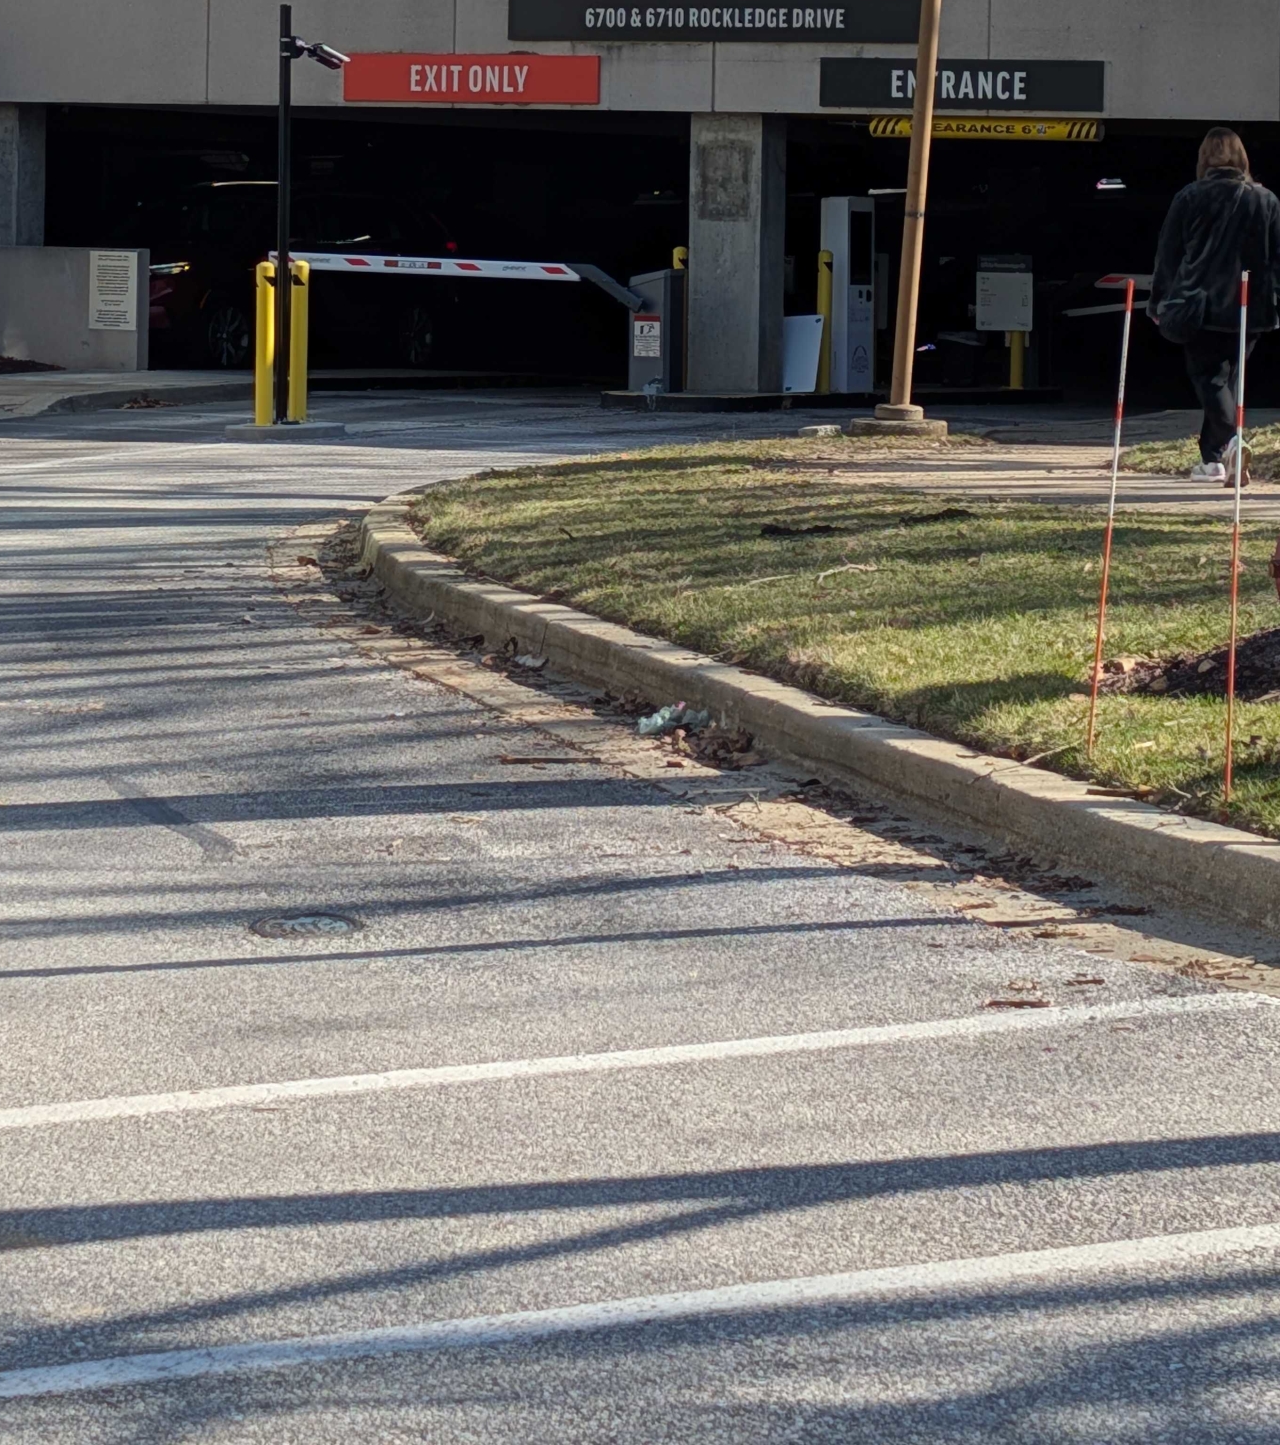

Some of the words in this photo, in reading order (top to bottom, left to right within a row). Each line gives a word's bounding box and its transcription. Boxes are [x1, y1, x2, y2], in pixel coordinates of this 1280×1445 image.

[585, 7, 625, 28] 6700
[630, 8, 641, 27] &
[645, 8, 684, 28] 6710
[689, 8, 788, 29] ROCKLEDGE
[792, 8, 846, 29] DRIVE
[410, 64, 463, 92] EXIT
[468, 65, 529, 93] ONLY
[891, 69, 1027, 100] ENRANCE
[909, 122, 1016, 134] EARANCE
